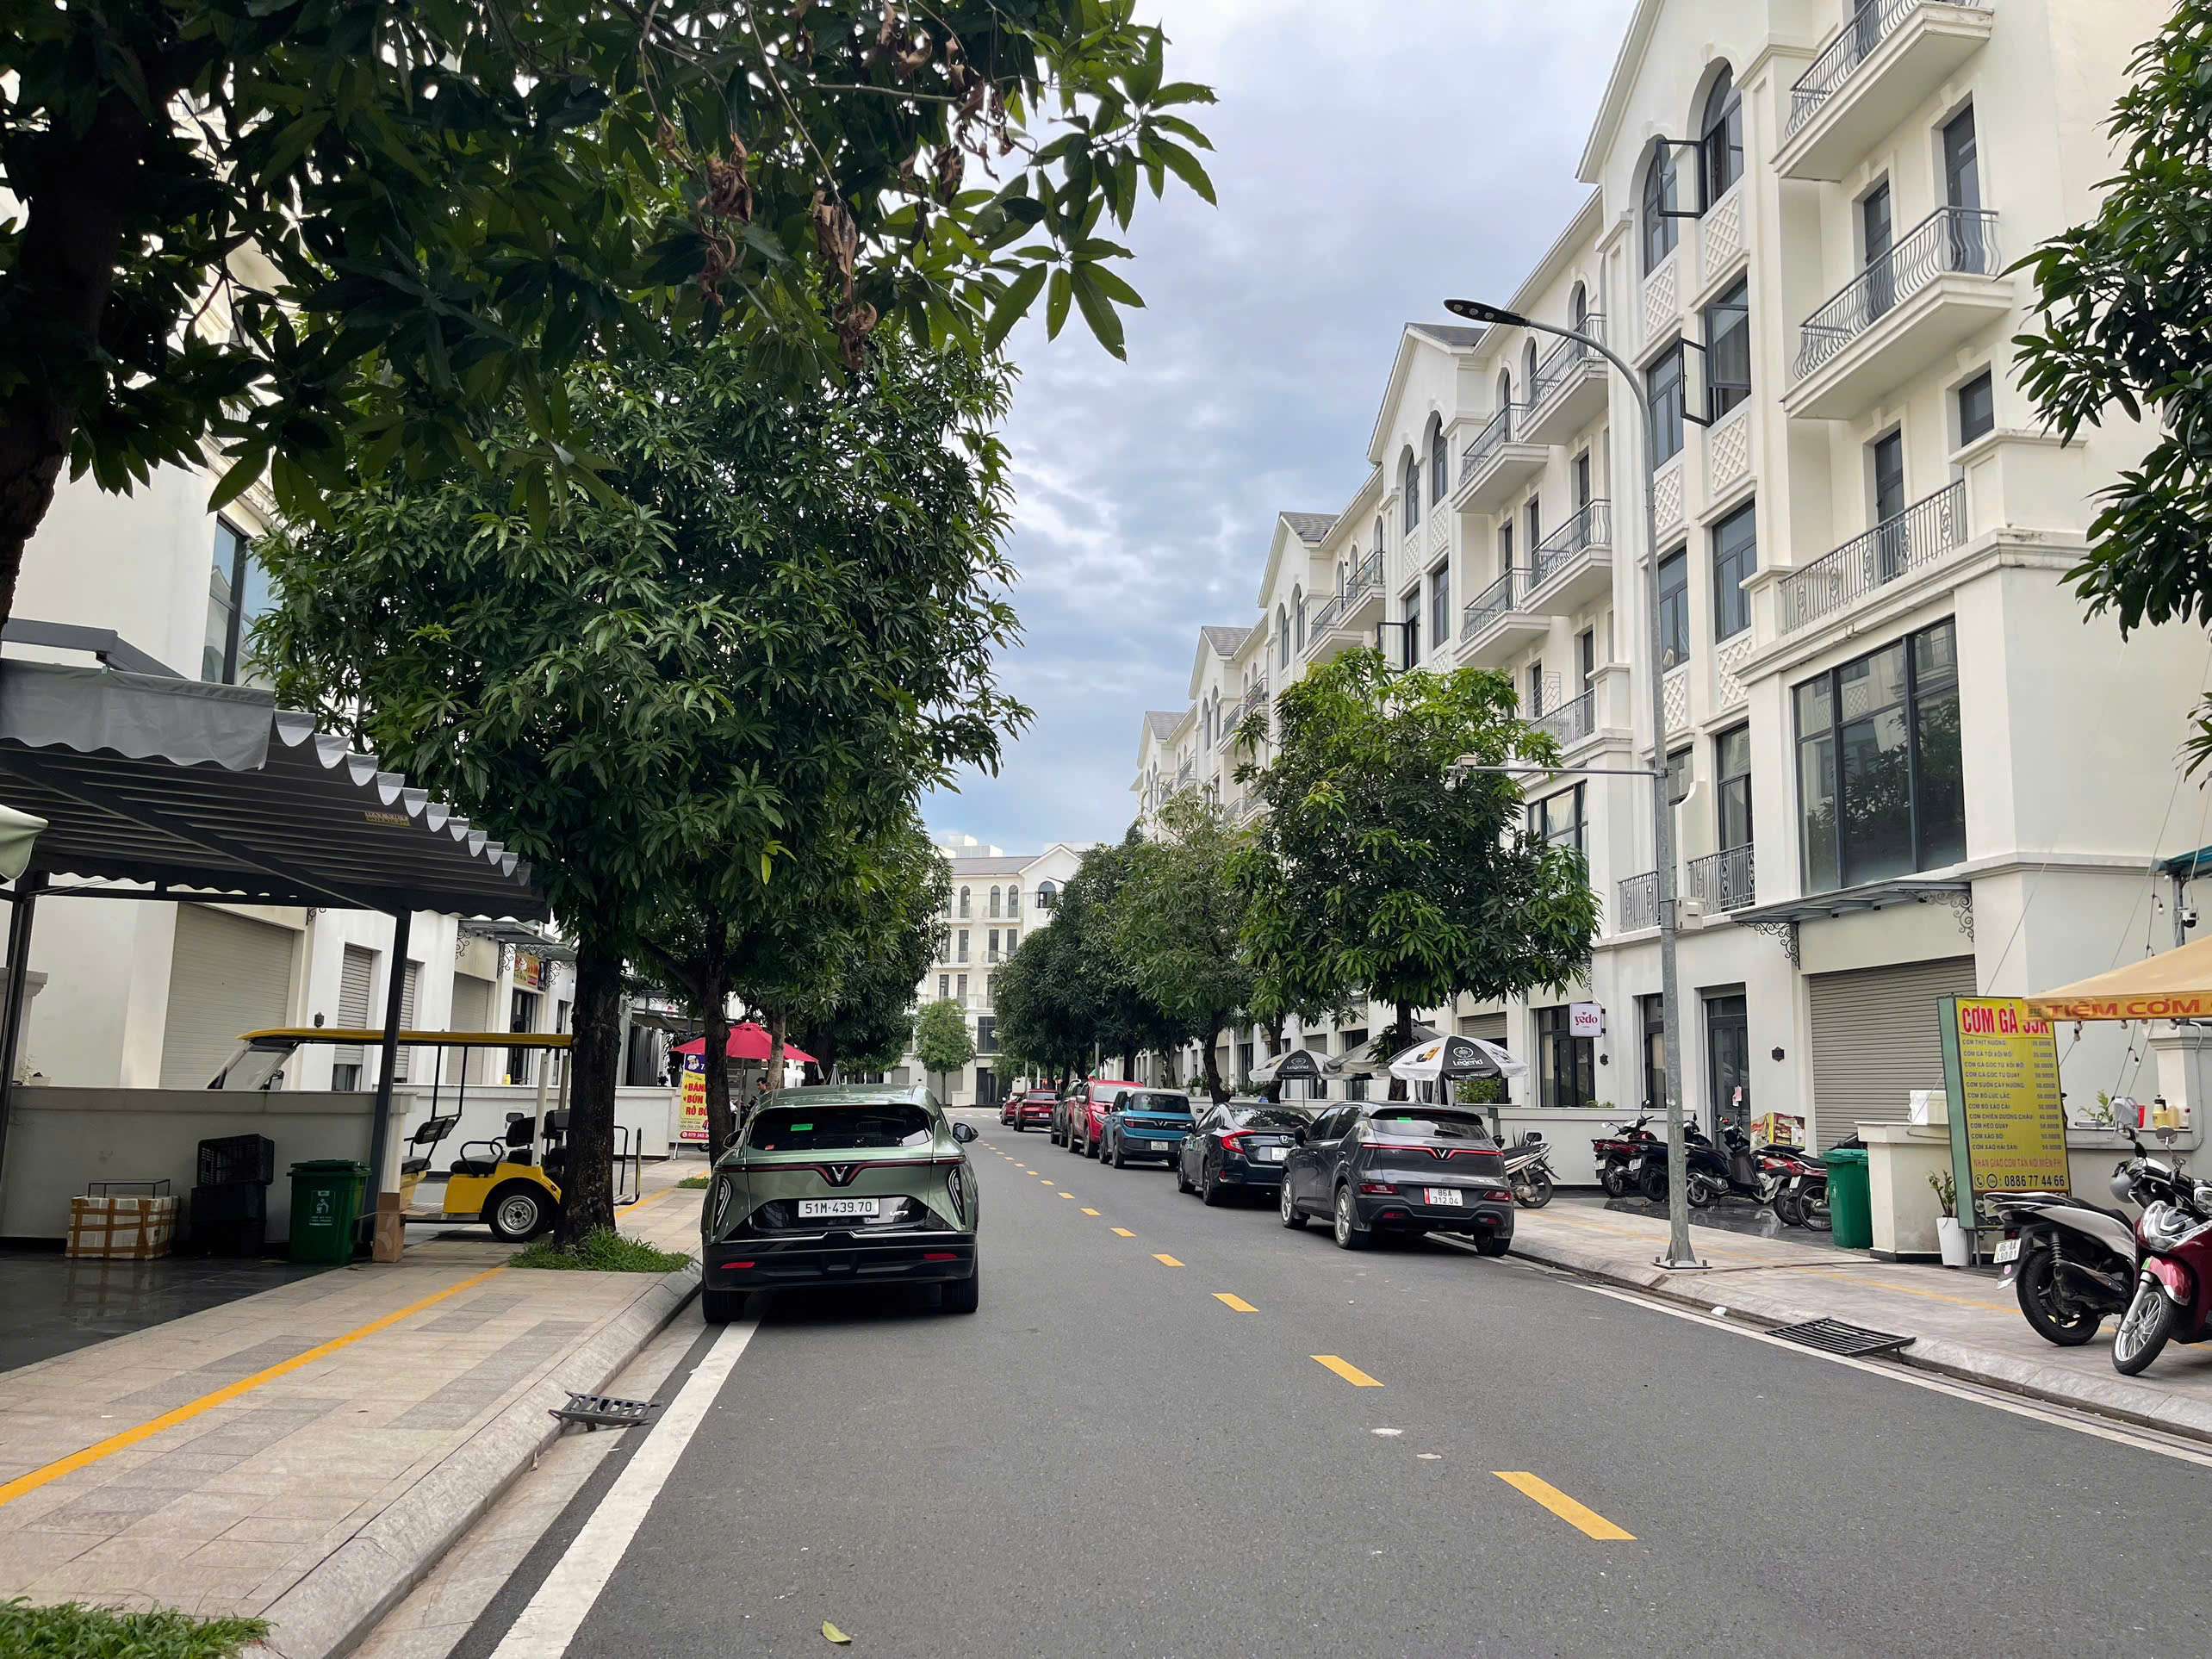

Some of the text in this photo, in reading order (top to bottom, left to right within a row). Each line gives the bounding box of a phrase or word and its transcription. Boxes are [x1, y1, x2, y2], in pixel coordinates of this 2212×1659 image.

[2126, 998, 2200, 1016] CƠM
[1961, 1005, 1996, 1034] CƠM
[1998, 1002, 2019, 1034] GÀ
[687, 1093, 704, 1104] BÚN
[2004, 1175, 2027, 1187] 0886
[2028, 1175, 2039, 1187] 77
[2041, 1175, 2052, 1186] 44
[2054, 1175, 2065, 1187] 66
[805, 1202, 872, 1214] 51M-439.70
